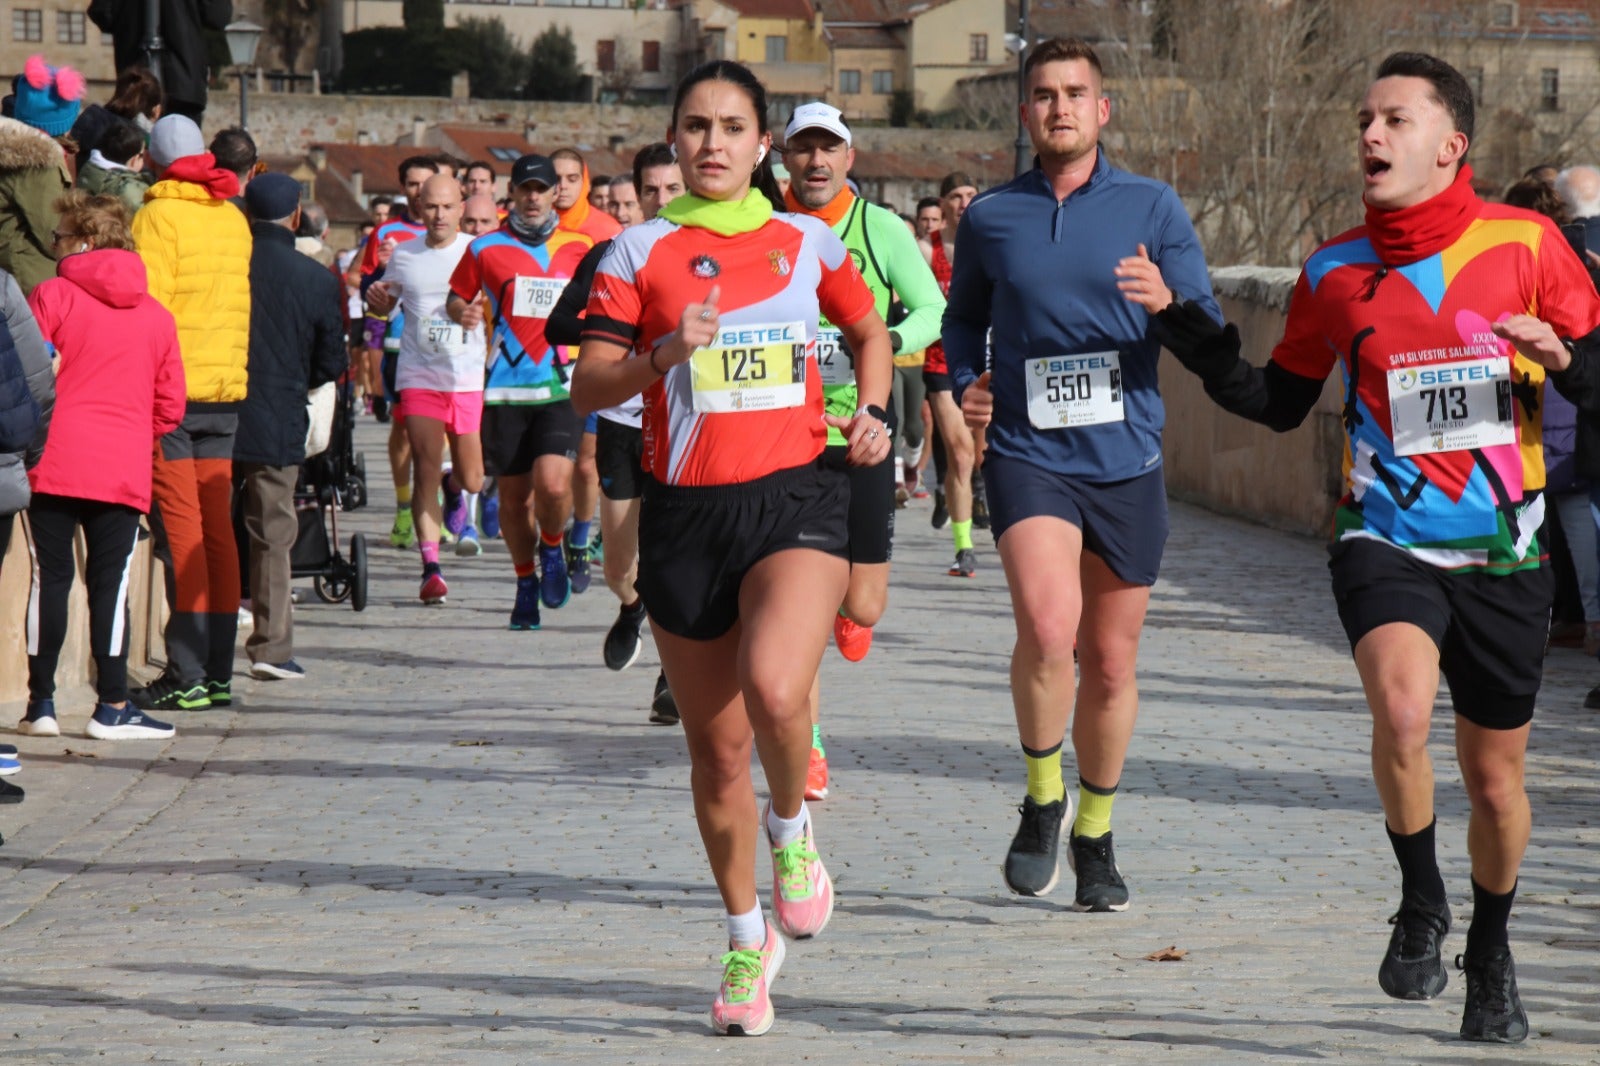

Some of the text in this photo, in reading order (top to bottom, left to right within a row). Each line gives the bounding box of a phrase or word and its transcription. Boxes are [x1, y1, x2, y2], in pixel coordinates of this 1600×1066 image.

[528, 288, 553, 304] 789
[428, 327, 451, 342] 577
[722, 328, 795, 345] SETEL
[1472, 332, 1497, 344] XXXIX
[721, 347, 767, 382] 125
[1049, 357, 1112, 372] SETEL
[1389, 354, 1405, 366] SAN
[1406, 349, 1447, 363] SILVESTRE
[1419, 365, 1497, 385] SETEL
[1046, 373, 1091, 403] 550
[1419, 386, 1468, 423] 713
[1428, 420, 1464, 430] ERNESTO
